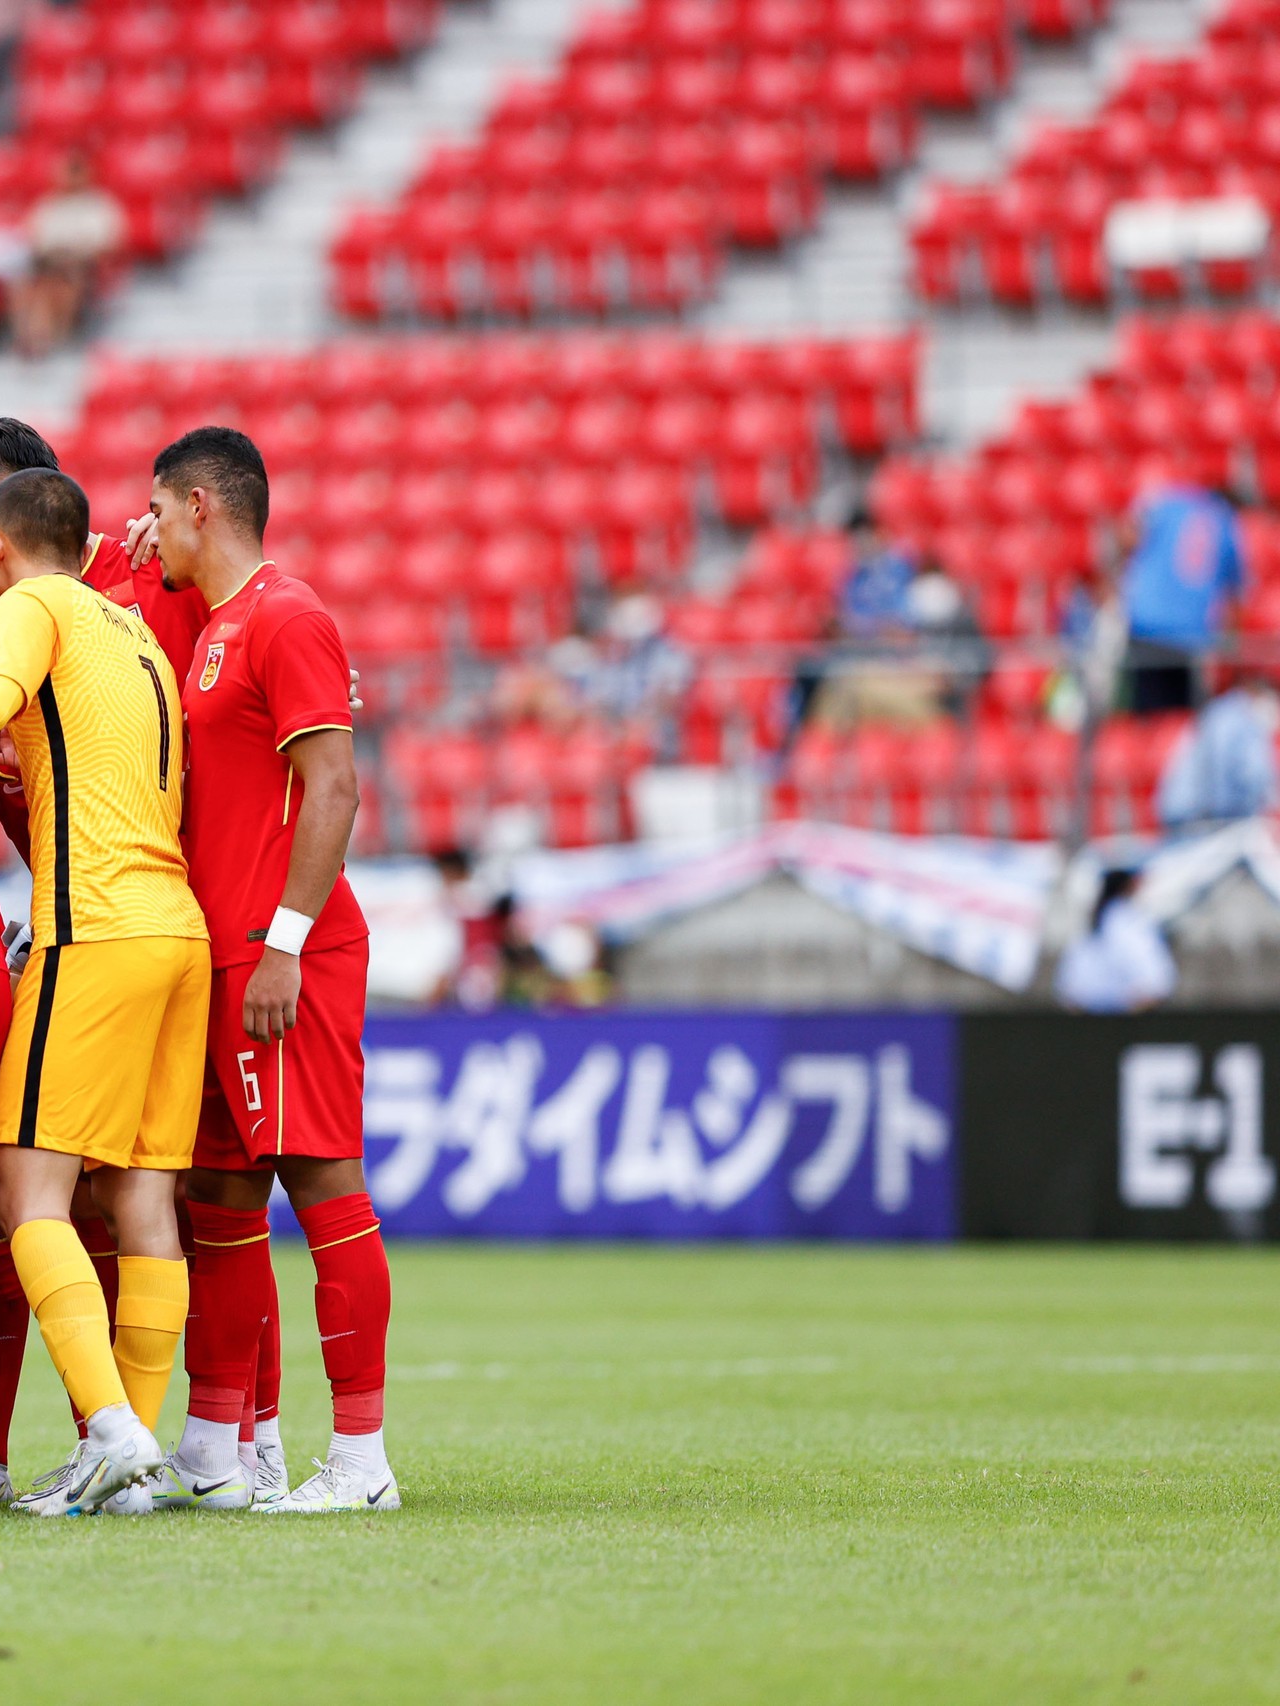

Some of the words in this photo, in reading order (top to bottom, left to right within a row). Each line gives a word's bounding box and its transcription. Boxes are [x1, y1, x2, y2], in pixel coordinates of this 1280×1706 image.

[138, 655, 170, 791] 1
[236, 1050, 262, 1111] 6
[1120, 1042, 1276, 1212] E-1
